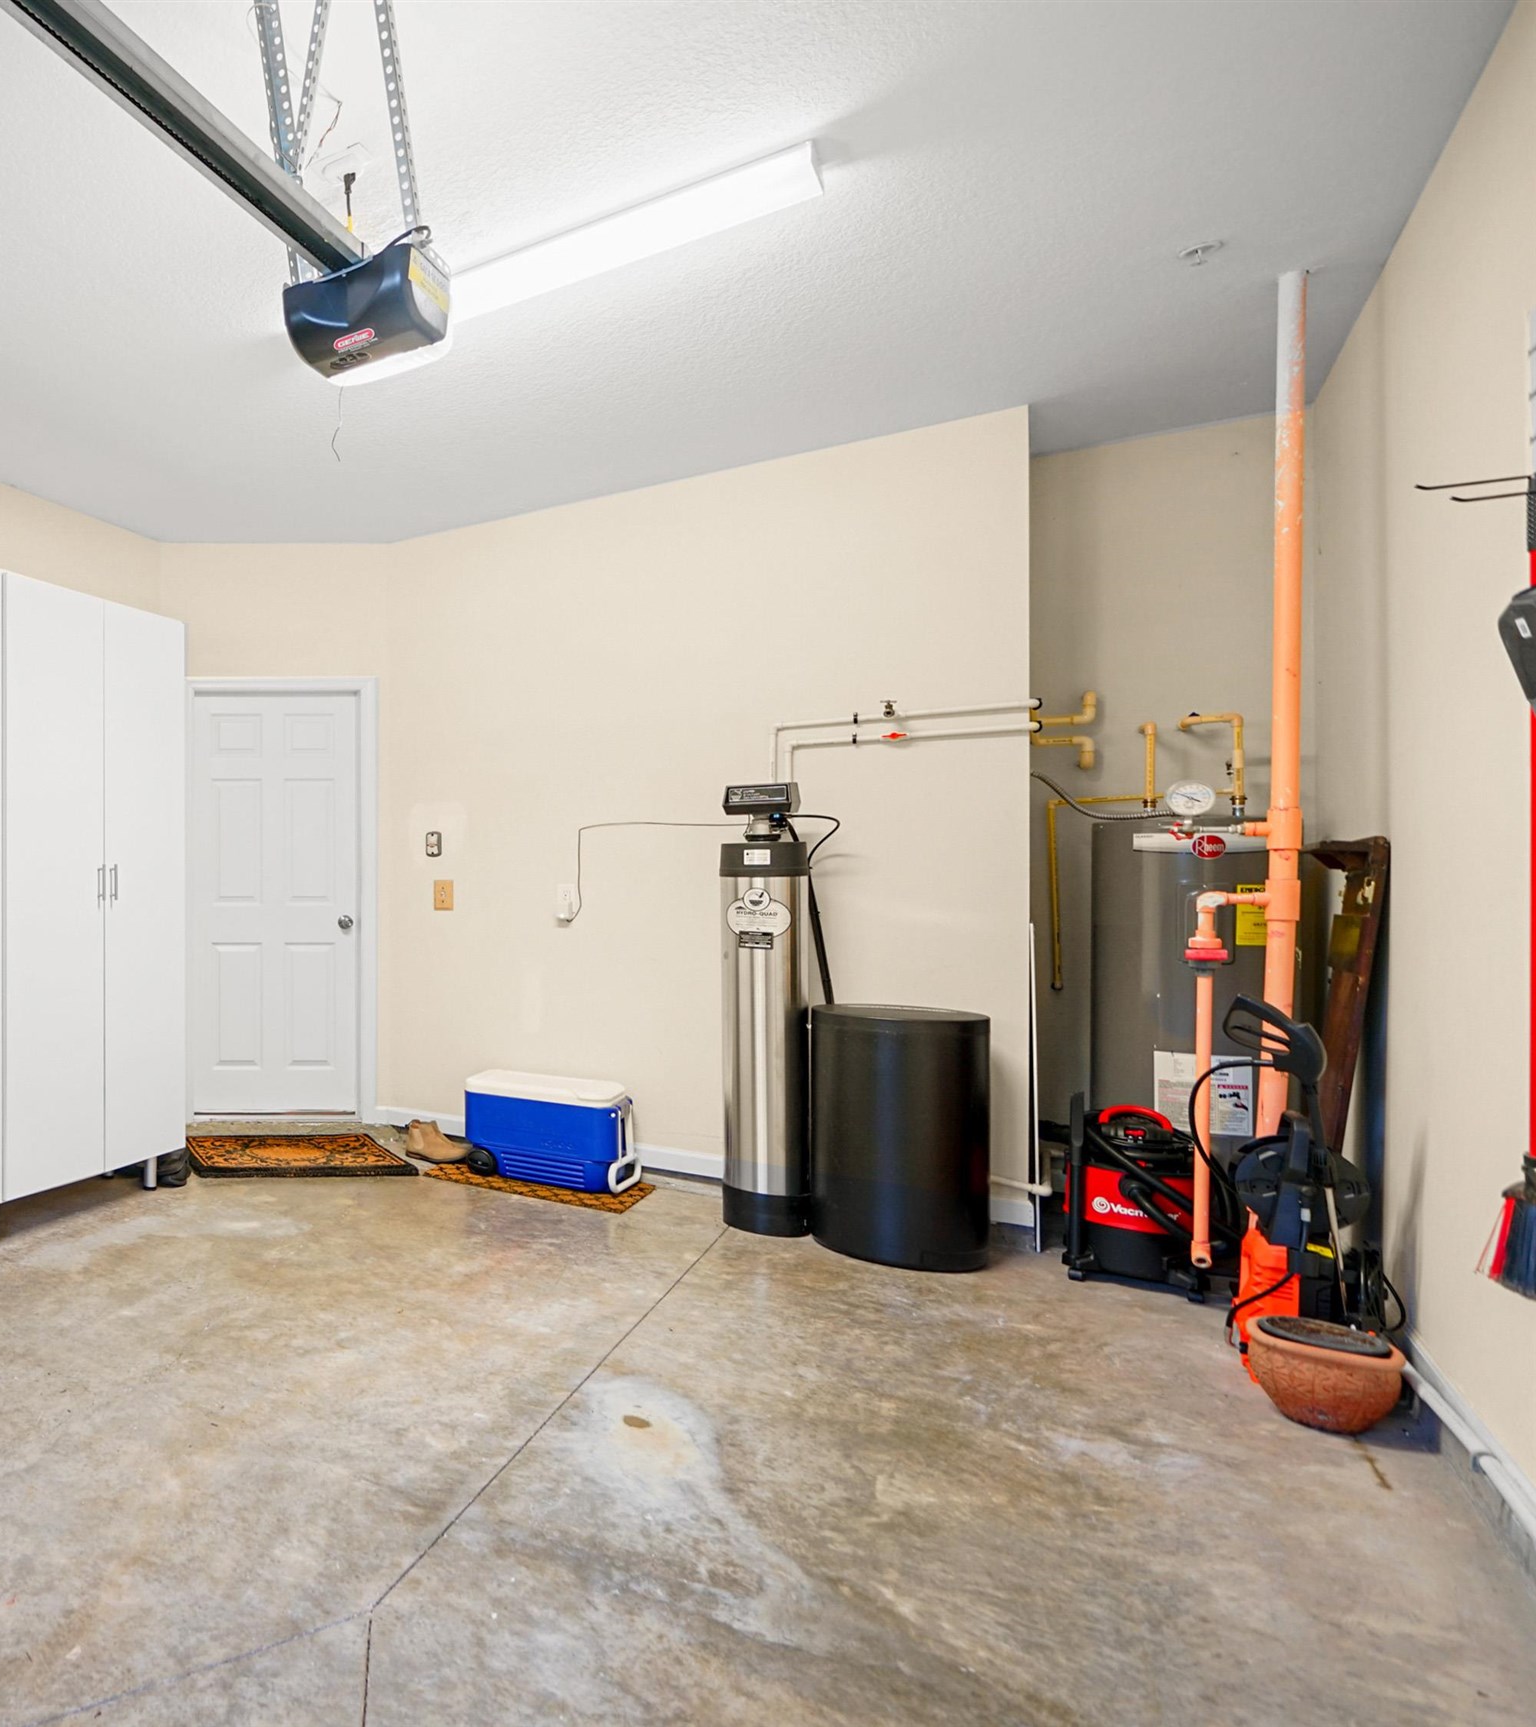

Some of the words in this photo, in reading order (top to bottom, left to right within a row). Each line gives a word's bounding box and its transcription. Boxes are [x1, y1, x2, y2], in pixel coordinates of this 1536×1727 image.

[337, 331, 370, 348] GENIE
[1195, 835, 1225, 855] Rheem
[1109, 1202, 1180, 1221] Vacmer
